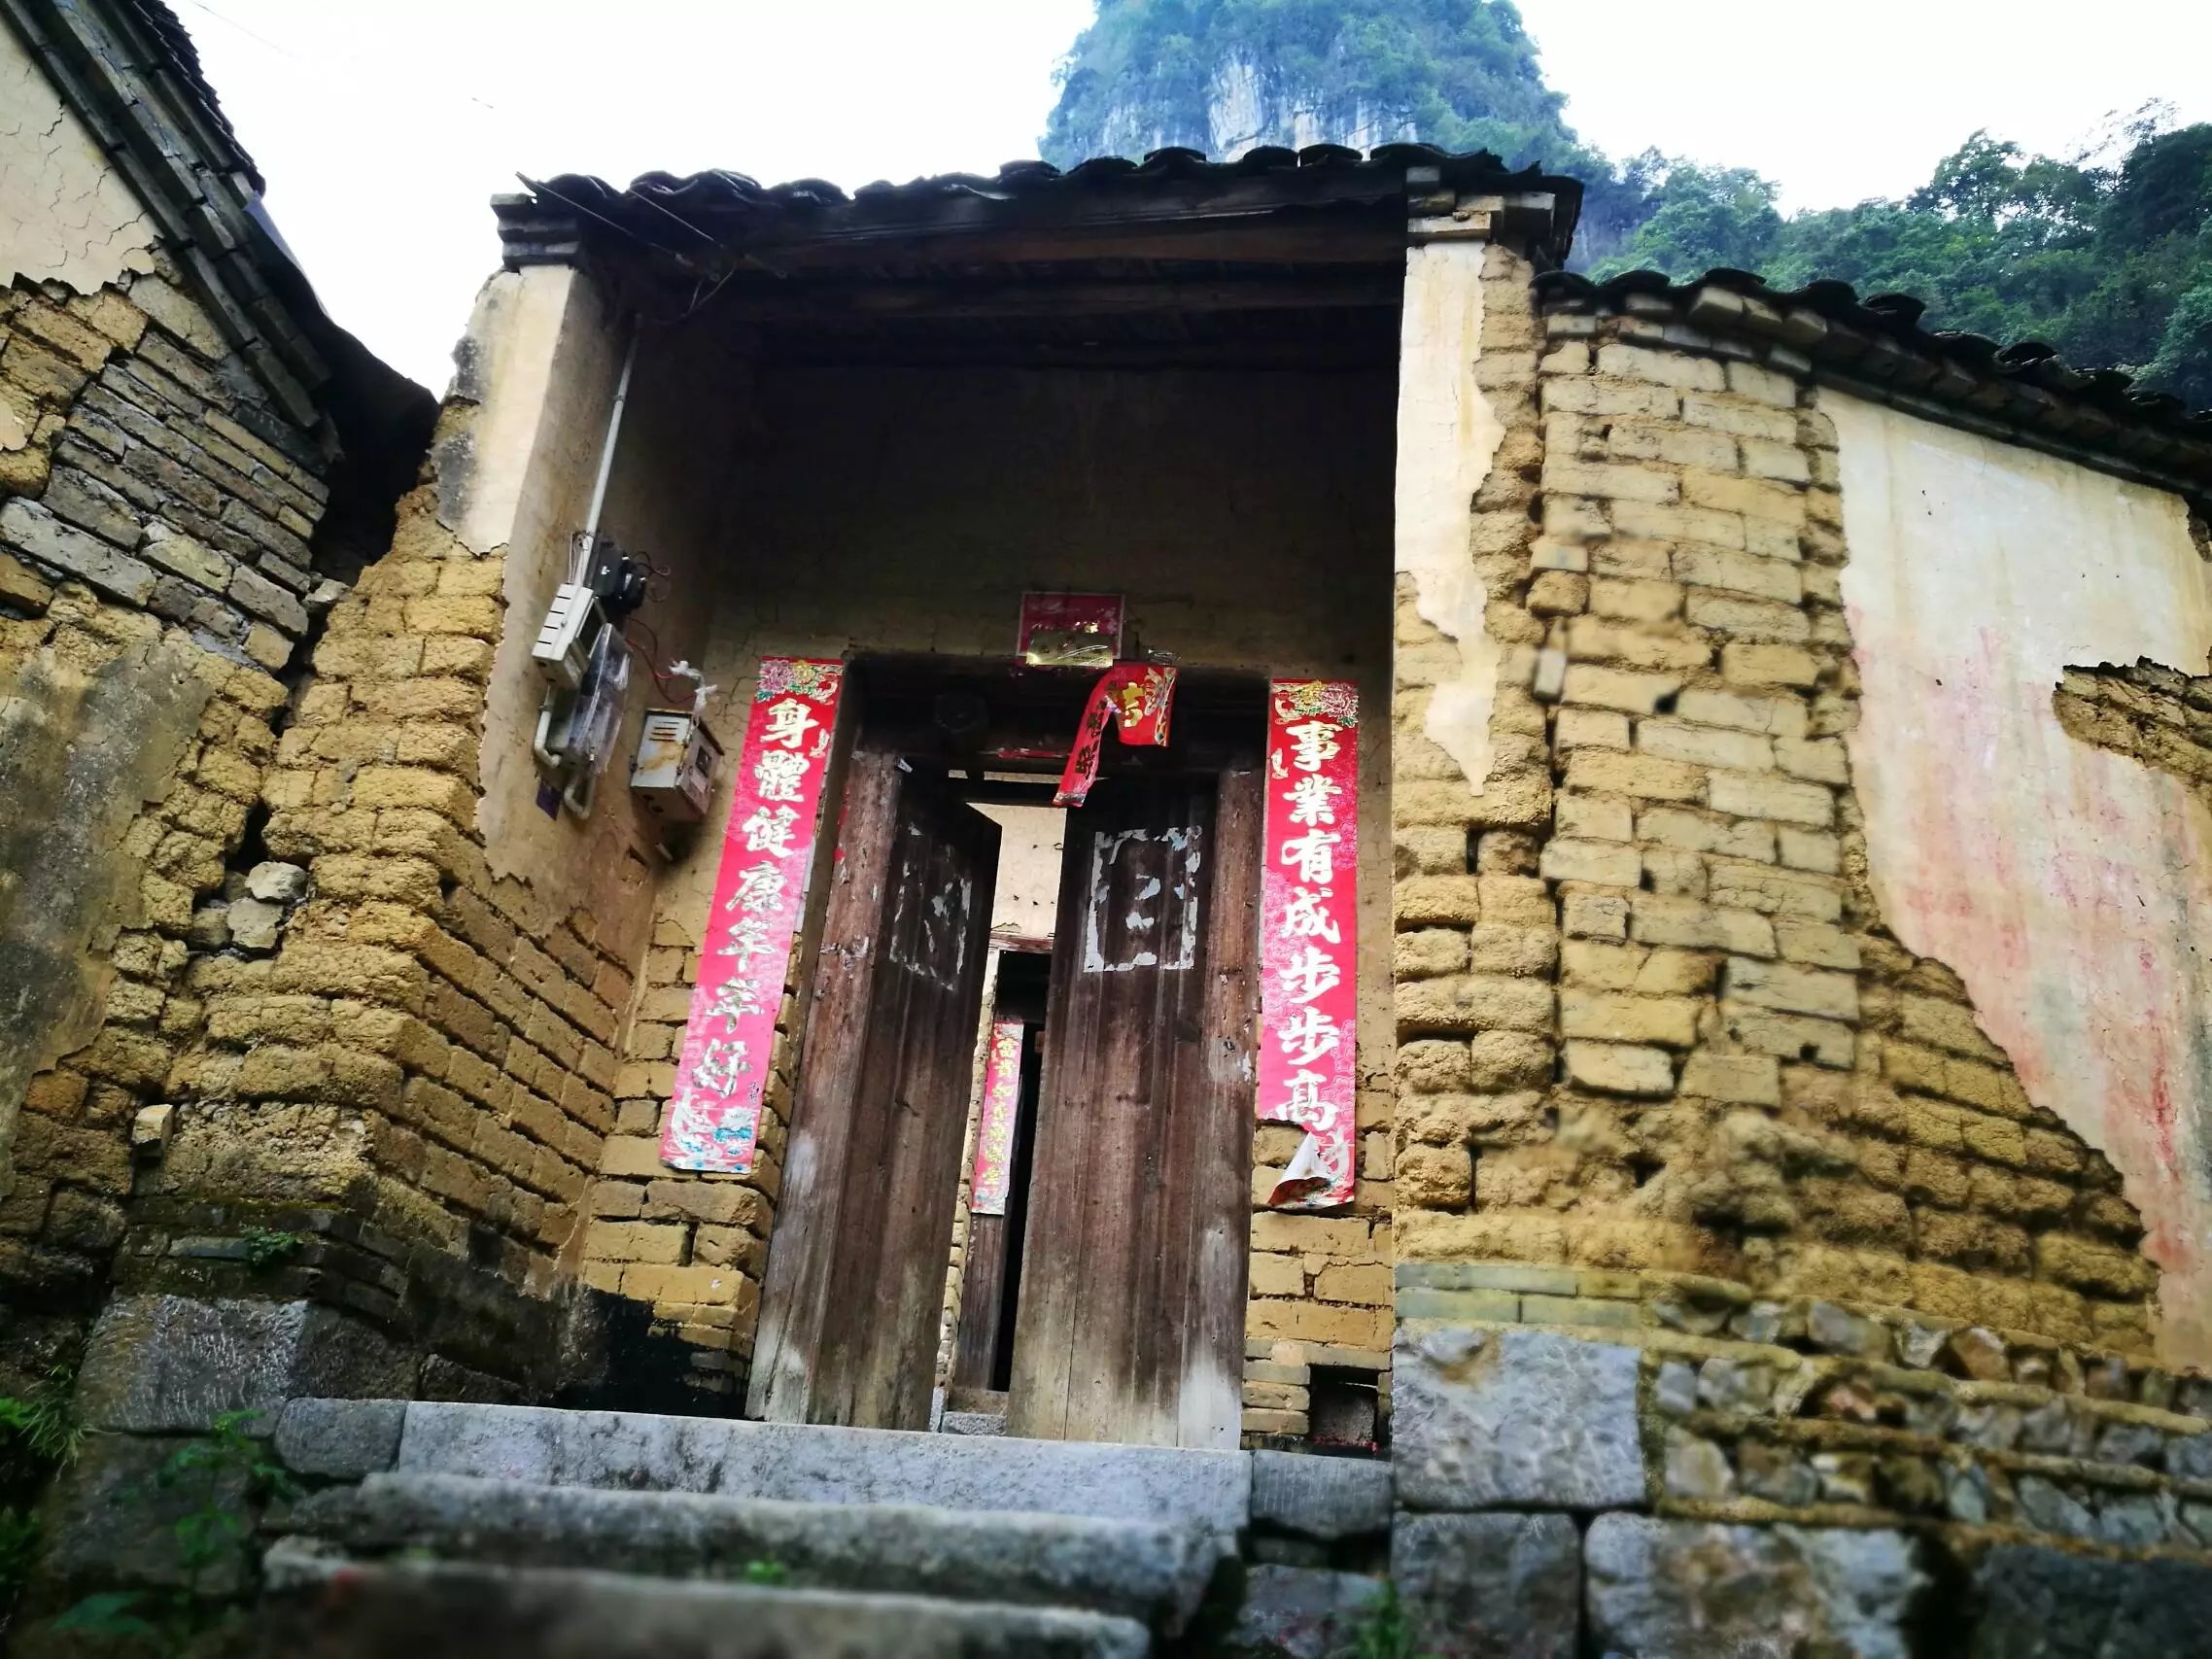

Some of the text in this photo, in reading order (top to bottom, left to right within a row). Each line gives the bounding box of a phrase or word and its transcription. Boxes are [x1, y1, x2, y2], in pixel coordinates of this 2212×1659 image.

[691, 698, 819, 1098] 身體健康年年好
[1276, 720, 1343, 1131] 事業有成步步高
